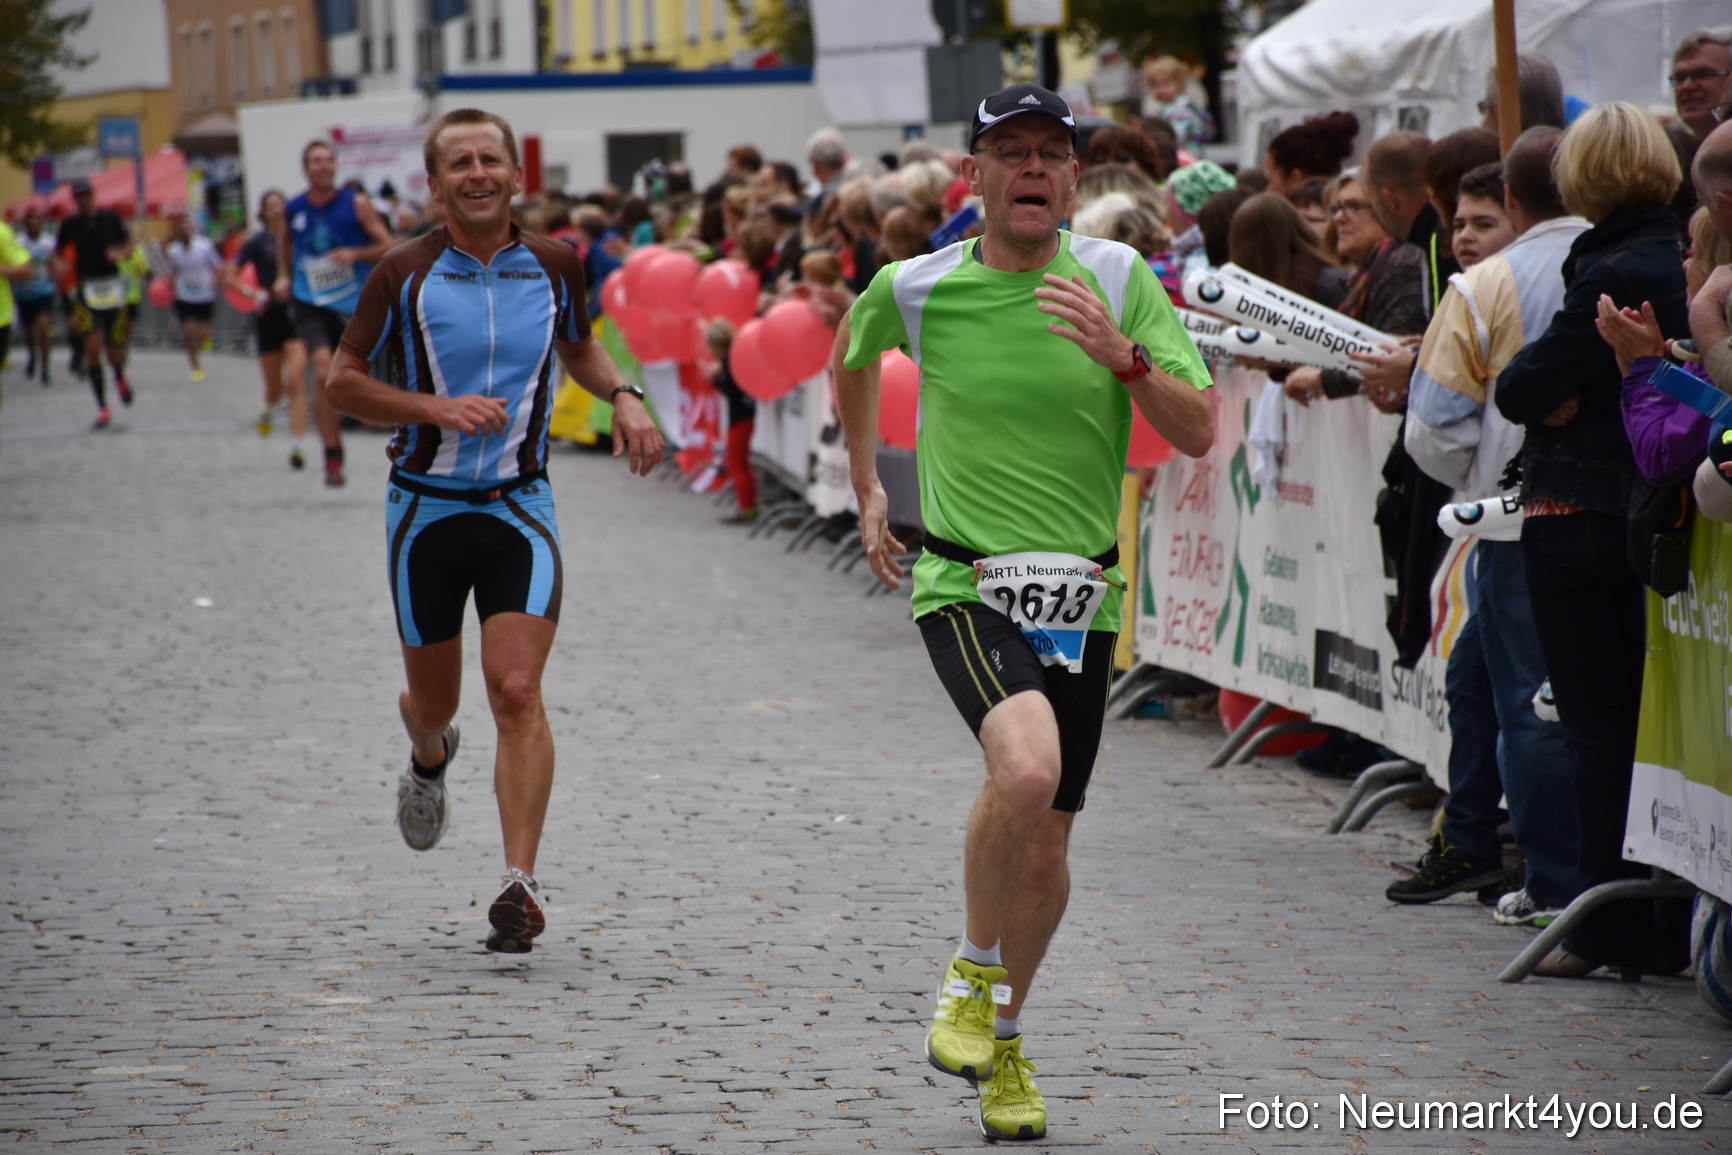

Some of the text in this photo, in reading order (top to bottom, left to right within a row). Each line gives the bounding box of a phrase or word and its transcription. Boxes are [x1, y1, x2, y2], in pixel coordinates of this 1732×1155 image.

[982, 566, 1024, 582] PARTL
[994, 582, 1095, 628] 2613
[1028, 634, 1060, 656] Tho
